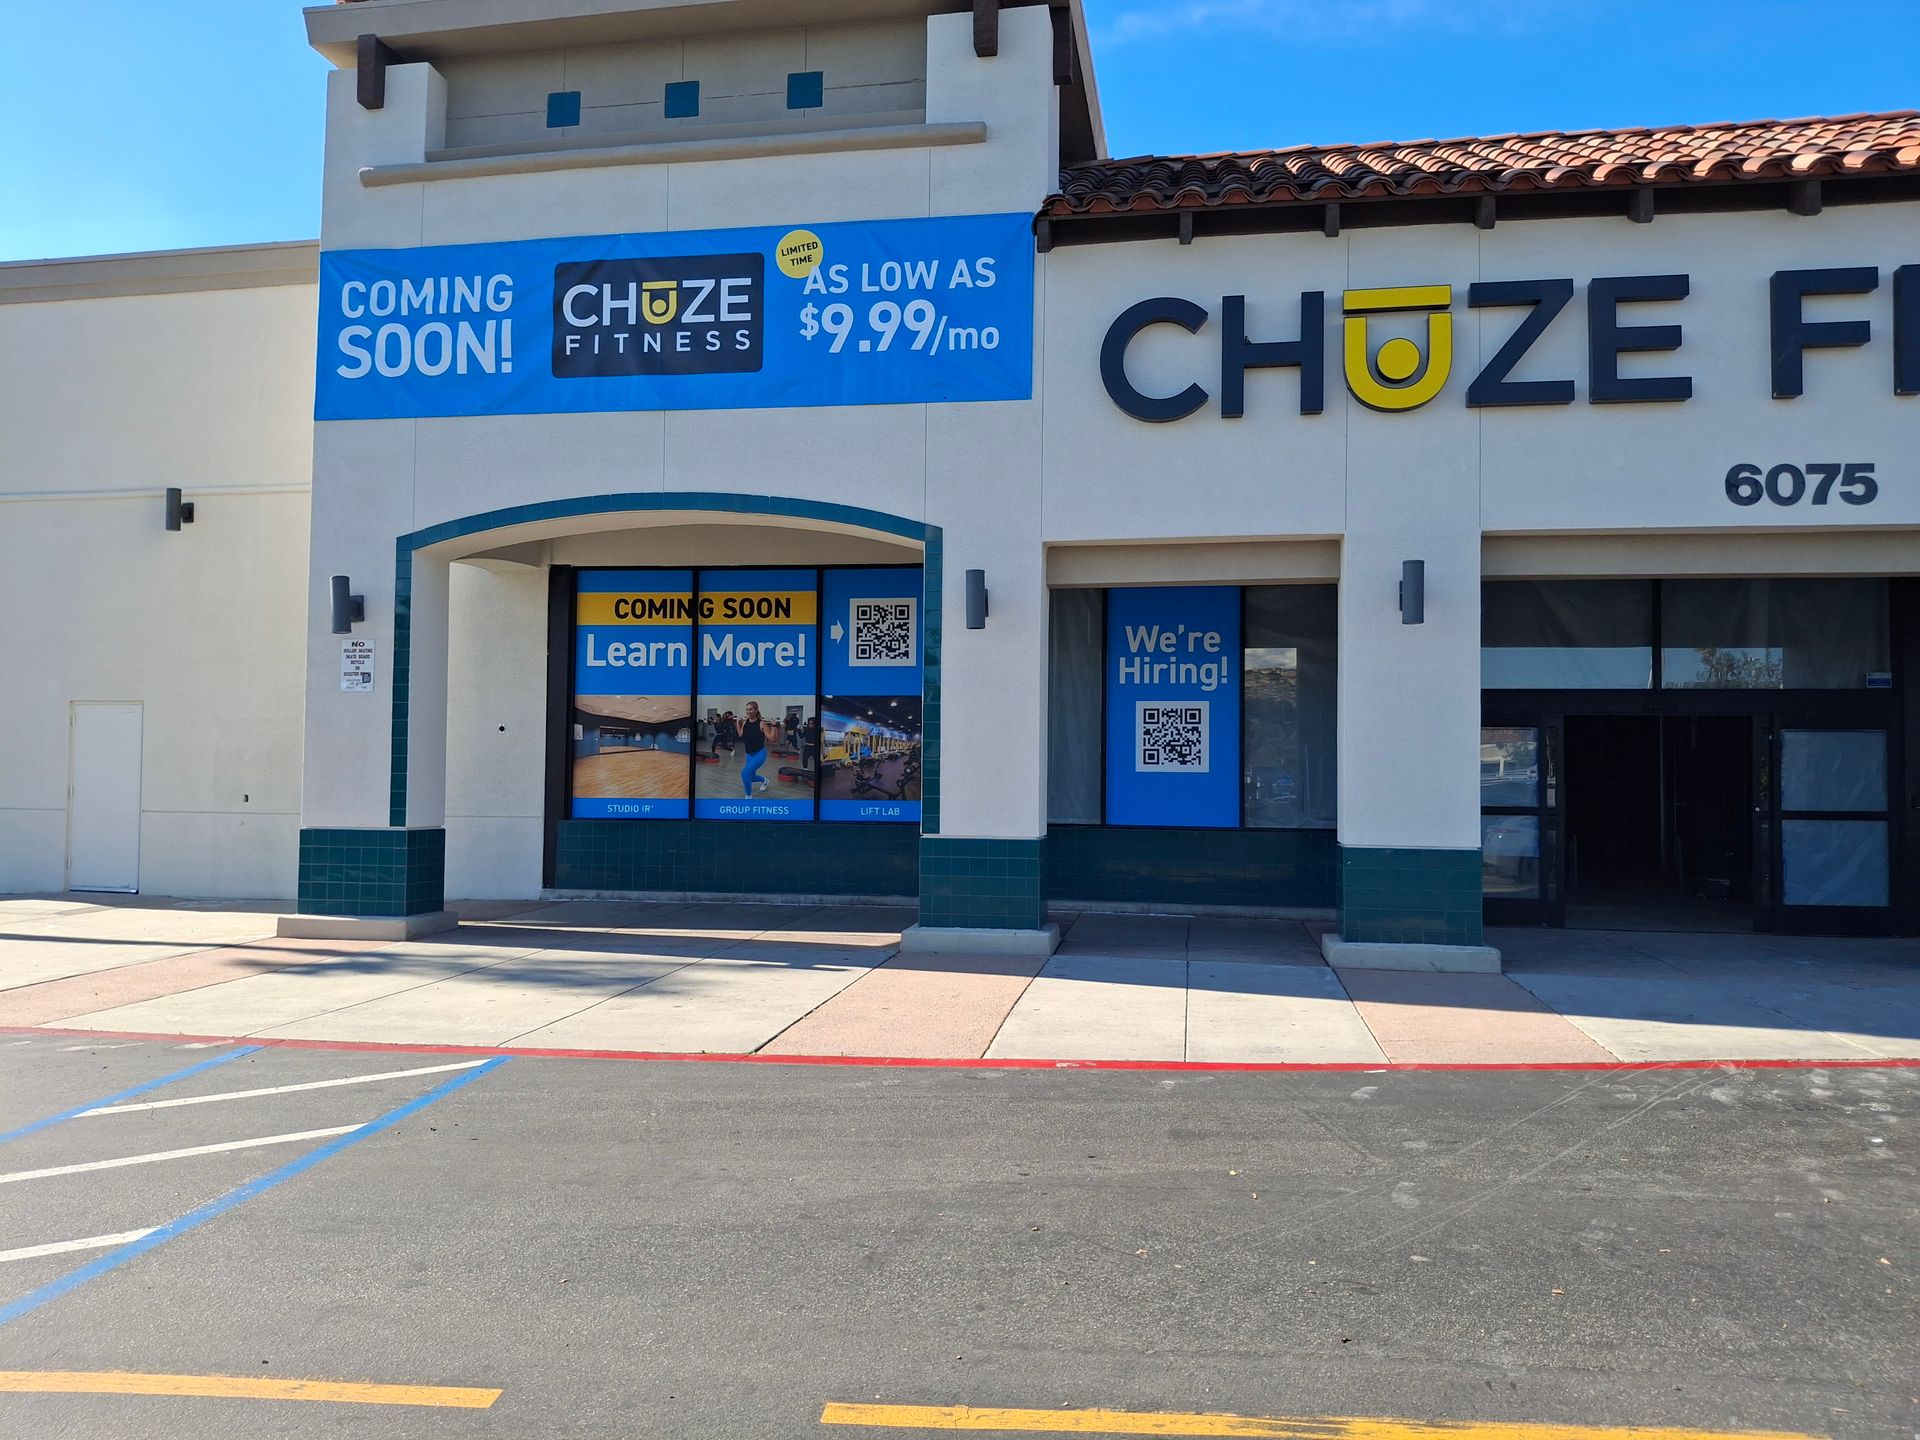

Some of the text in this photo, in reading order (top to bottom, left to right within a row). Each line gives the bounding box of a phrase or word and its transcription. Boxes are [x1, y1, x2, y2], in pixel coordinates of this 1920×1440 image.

[781, 241, 819, 257] LIMITED
[790, 255, 813, 267] TIME
[803, 257, 996, 295] AS LOW AS
[341, 274, 513, 319] COMING
[562, 277, 753, 328] CHUZE
[565, 329, 751, 356] FITNESS
[800, 299, 1000, 356] $9.99/mo
[336, 318, 513, 379] SOON!
[1099, 274, 1694, 424] CHUZE
[1724, 463, 1879, 506] 6075
[614, 596, 791, 619] COMING SOON
[586, 633, 806, 667] Learn More!
[1125, 624, 1221, 653] We're
[1119, 656, 1228, 692] Hiring!
[607, 804, 639, 813] STUDIO
[719, 805, 790, 815] GROUP FITNESS
[860, 807, 900, 816] LIFT LAB
